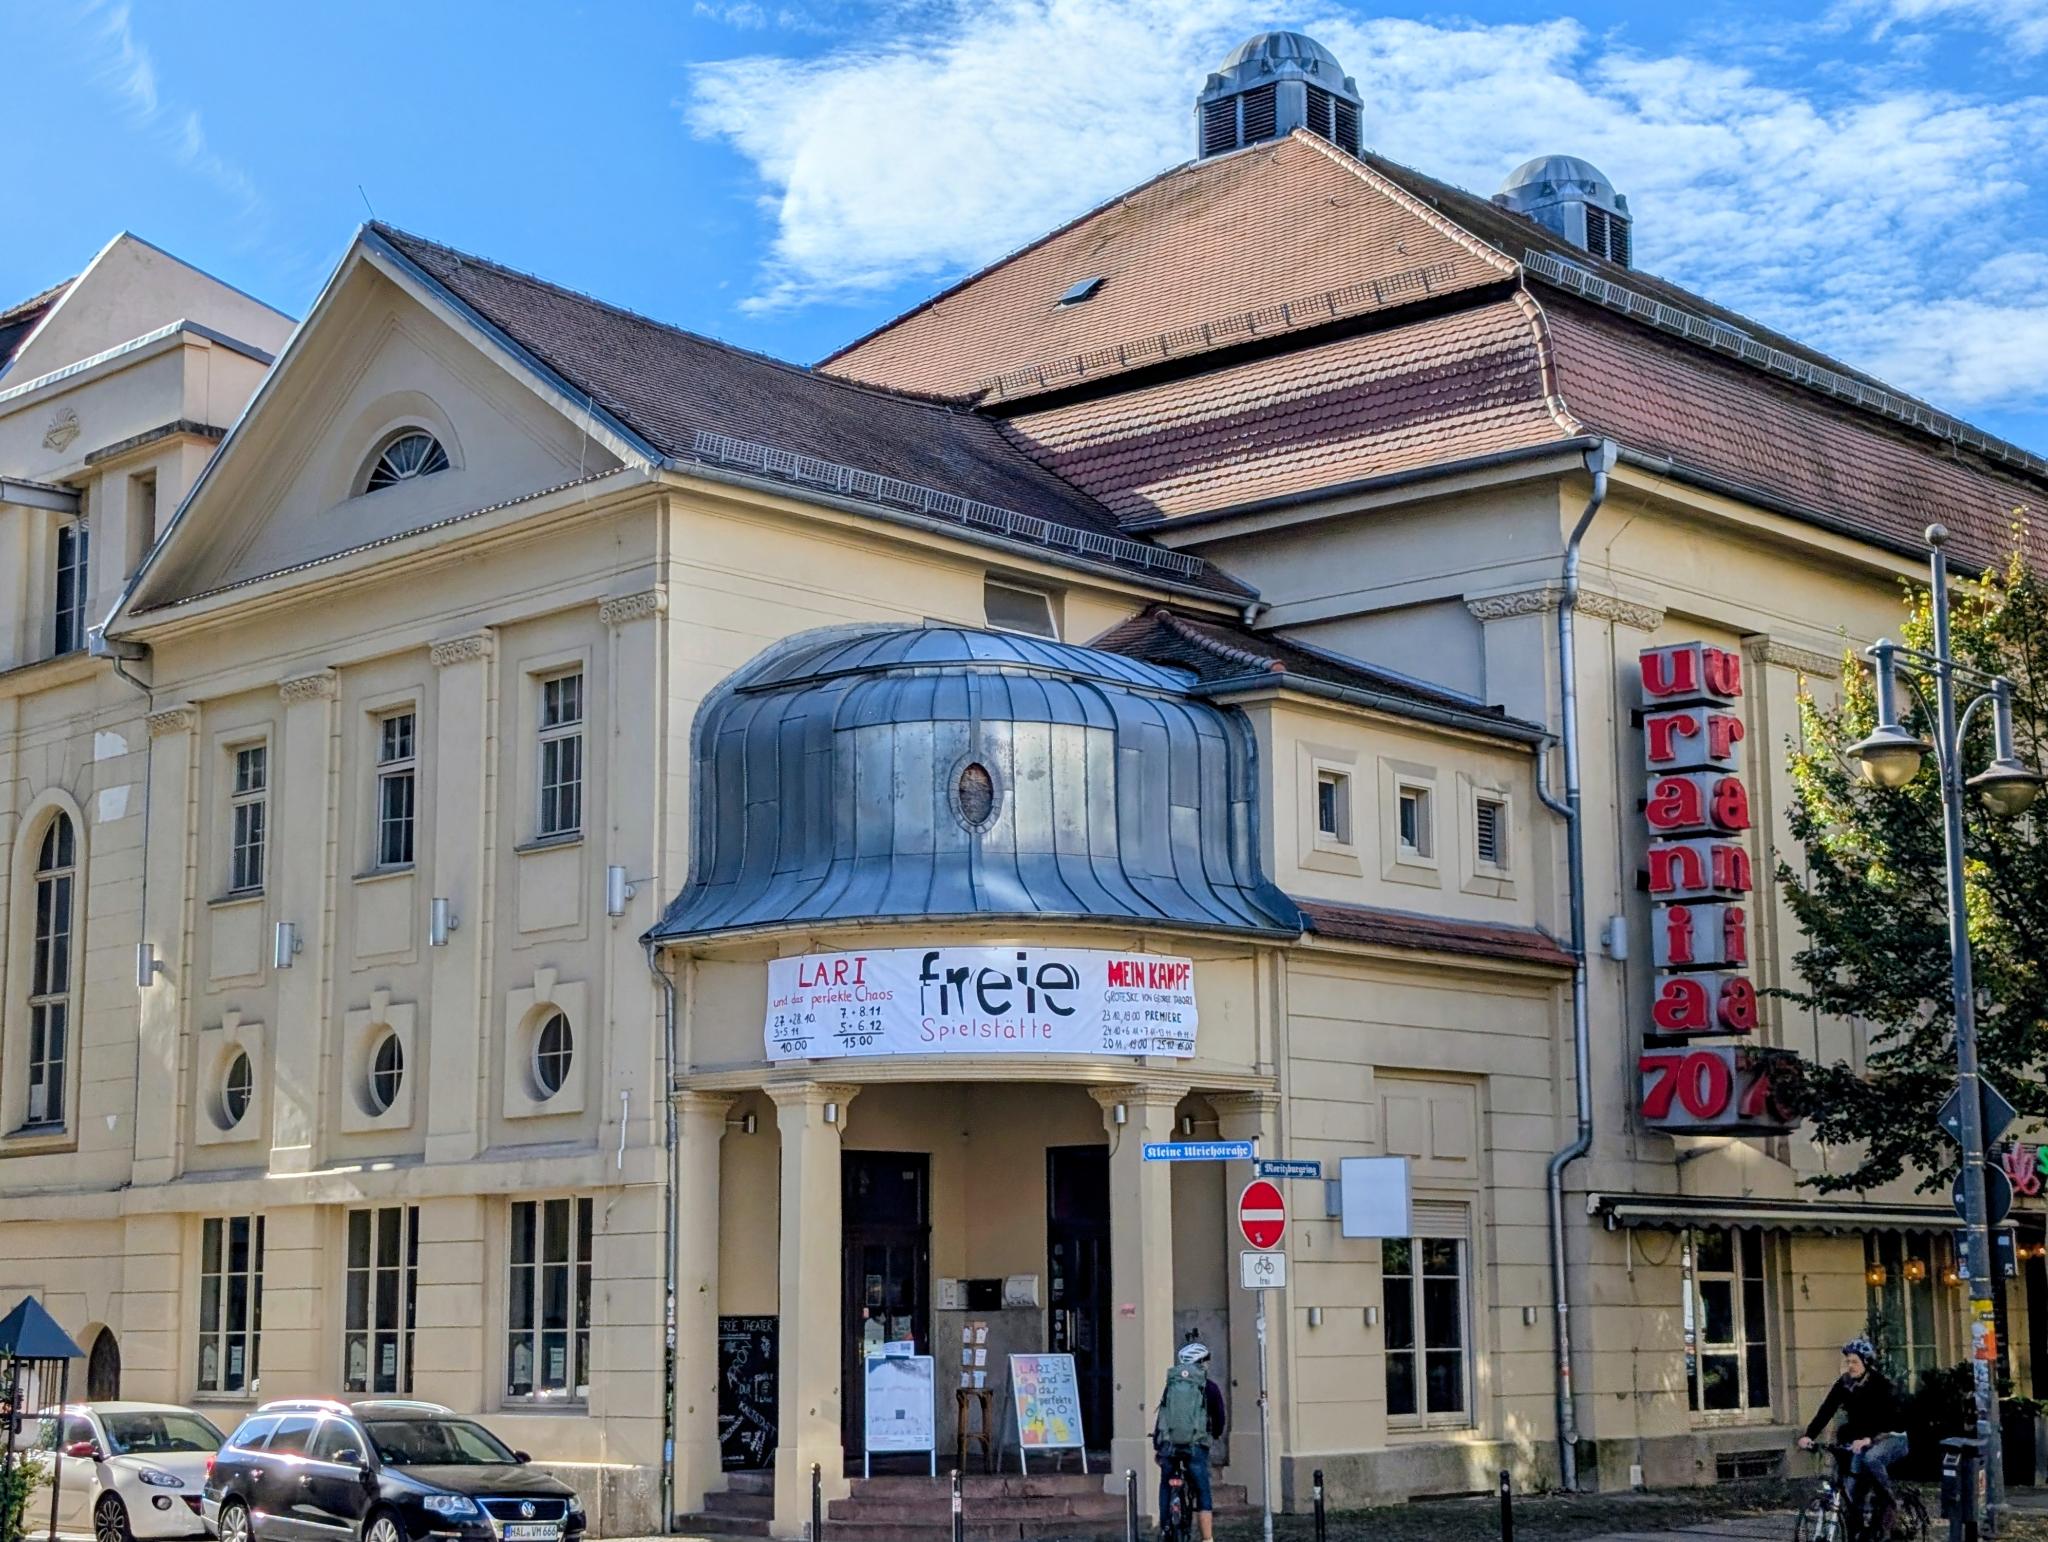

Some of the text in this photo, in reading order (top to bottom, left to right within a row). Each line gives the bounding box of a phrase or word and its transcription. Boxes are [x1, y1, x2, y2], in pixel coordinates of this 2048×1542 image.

[799, 957, 867, 988] LARI
[1108, 960, 1190, 991] MEIN KAMPF
[919, 951, 1080, 1016] freie
[773, 985, 894, 1010] und das perfekte Chaos
[1144, 1010, 1183, 1024] PREMIERE
[920, 1017, 1052, 1042] Spielstätte
[1639, 1051, 1733, 1120] 70
[1147, 1145, 1249, 1160] Kleine Ulrichstraße
[1264, 1163, 1317, 1177] Moritzburgring
[742, 1319, 774, 1333] THEATER
[1020, 1363, 1051, 1375] LARI
[1037, 1372, 1060, 1384] und
[511, 1526, 556, 1537] HAL VM 666
